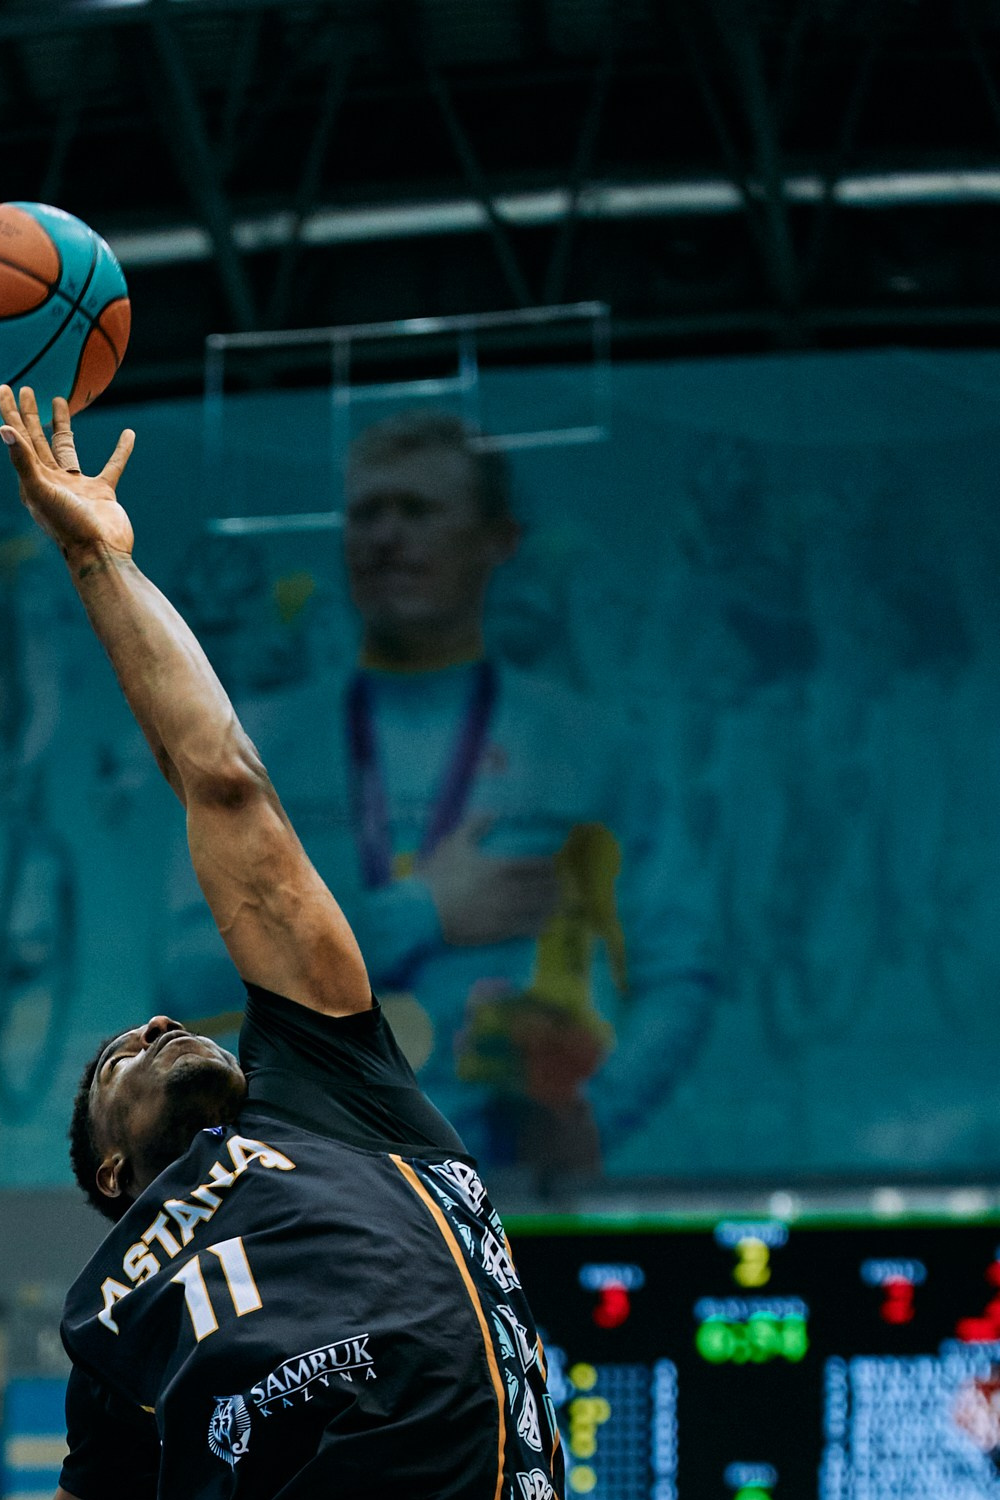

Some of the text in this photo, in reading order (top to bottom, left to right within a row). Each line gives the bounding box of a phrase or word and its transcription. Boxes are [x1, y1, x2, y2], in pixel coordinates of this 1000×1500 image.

[97, 1135, 297, 1336] ASTANA
[170, 1236, 263, 1343] 11
[250, 1337, 374, 1405] SAMRUK
[259, 1366, 377, 1418] KAZYNA
